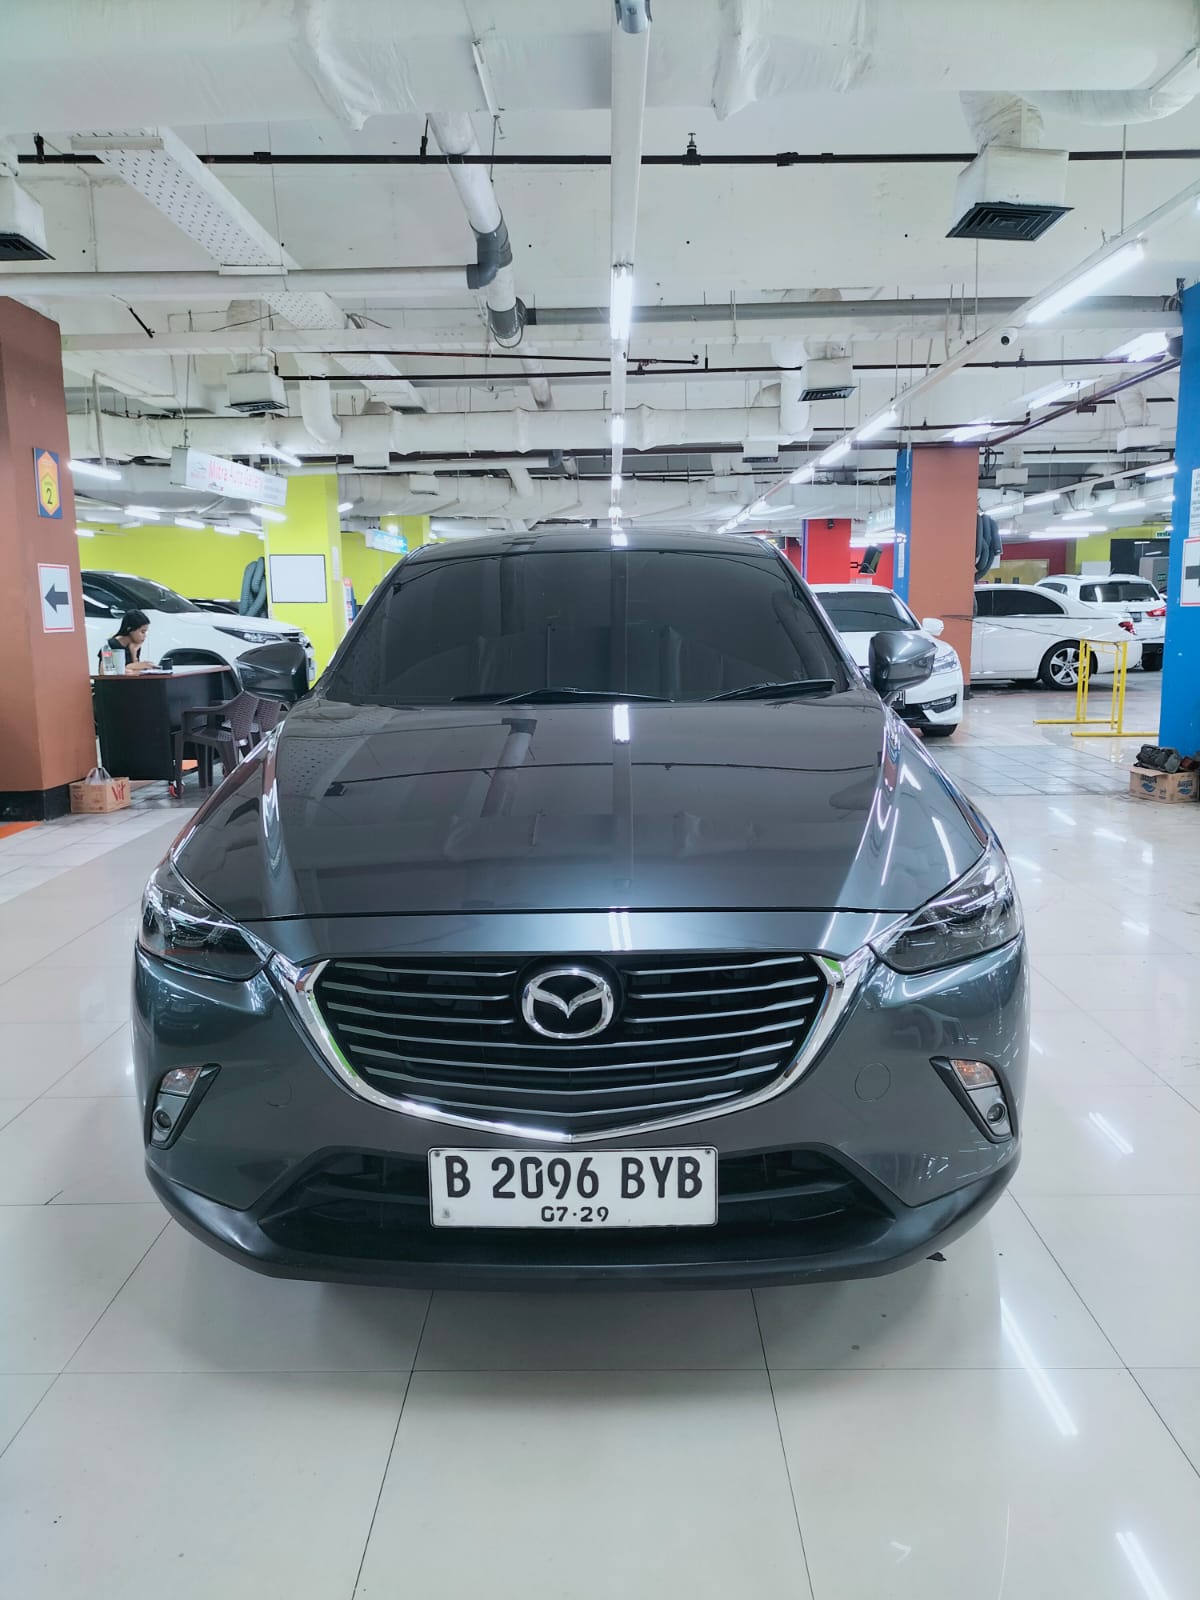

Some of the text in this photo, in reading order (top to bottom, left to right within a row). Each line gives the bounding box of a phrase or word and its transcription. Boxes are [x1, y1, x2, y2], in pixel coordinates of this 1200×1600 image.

[46, 487, 53, 505] 2
[111, 781, 126, 801] Vit
[445, 1155, 703, 1200] B 2096 BYB
